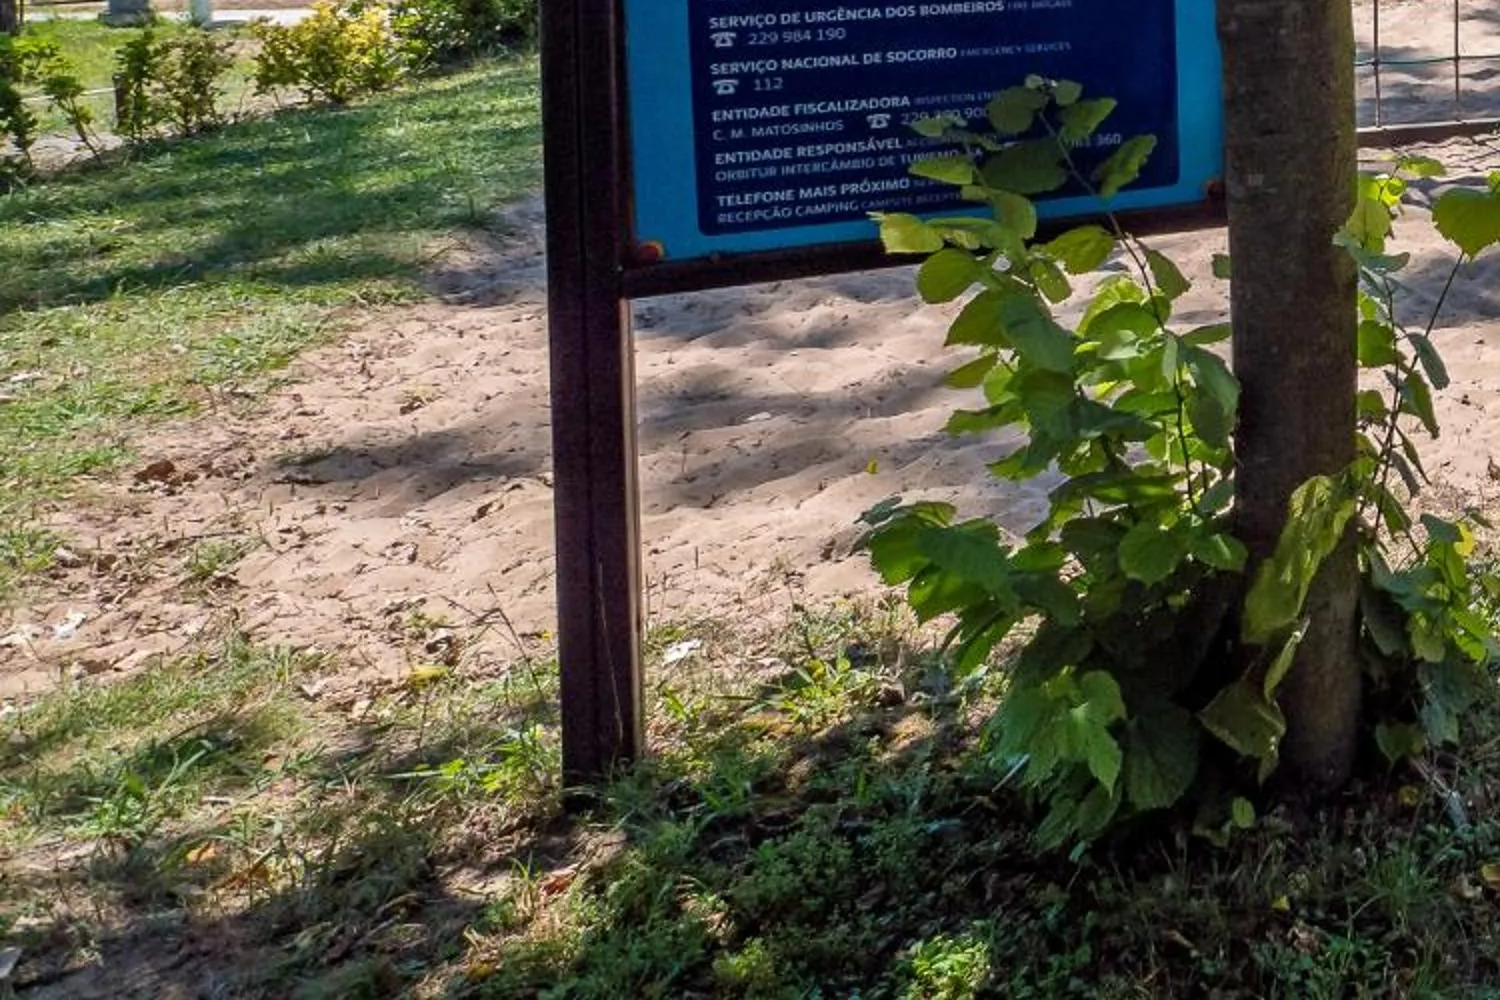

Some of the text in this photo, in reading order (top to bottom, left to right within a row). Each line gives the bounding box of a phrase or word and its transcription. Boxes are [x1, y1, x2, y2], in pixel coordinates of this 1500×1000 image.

[709, 13, 778, 29] SERVIÇO
[780, 11, 801, 25] DE
[804, 6, 882, 24] URGÊNCIA
[885, 4, 916, 19] DOS
[919, 0, 1005, 17] BOMBEIROS
[747, 30, 779, 46] 229
[816, 27, 847, 42] 190
[709, 59, 779, 75] SERVIÇO
[781, 54, 861, 70] NACIONAL
[863, 51, 883, 65] DE
[885, 47, 958, 64] SOCORRO
[753, 77, 784, 92] 112
[711, 105, 792, 123] ENTIDADE
[794, 95, 911, 116] FISCALIZADORA
[751, 119, 845, 137] MATOSINHOS
[714, 147, 793, 165] ENTIDADE
[796, 136, 903, 157] RESPONSÁVEL
[715, 165, 777, 182] ORBITUR
[781, 157, 875, 176] INTERCÂMBIO
[877, 155, 896, 168] DE
[716, 188, 796, 207] TELEFONE
[799, 183, 837, 200] MAIS
[840, 176, 911, 195] PRÓXIMO
[716, 205, 793, 224] RECEPÇÃO
[795, 199, 860, 216] CAMPING
